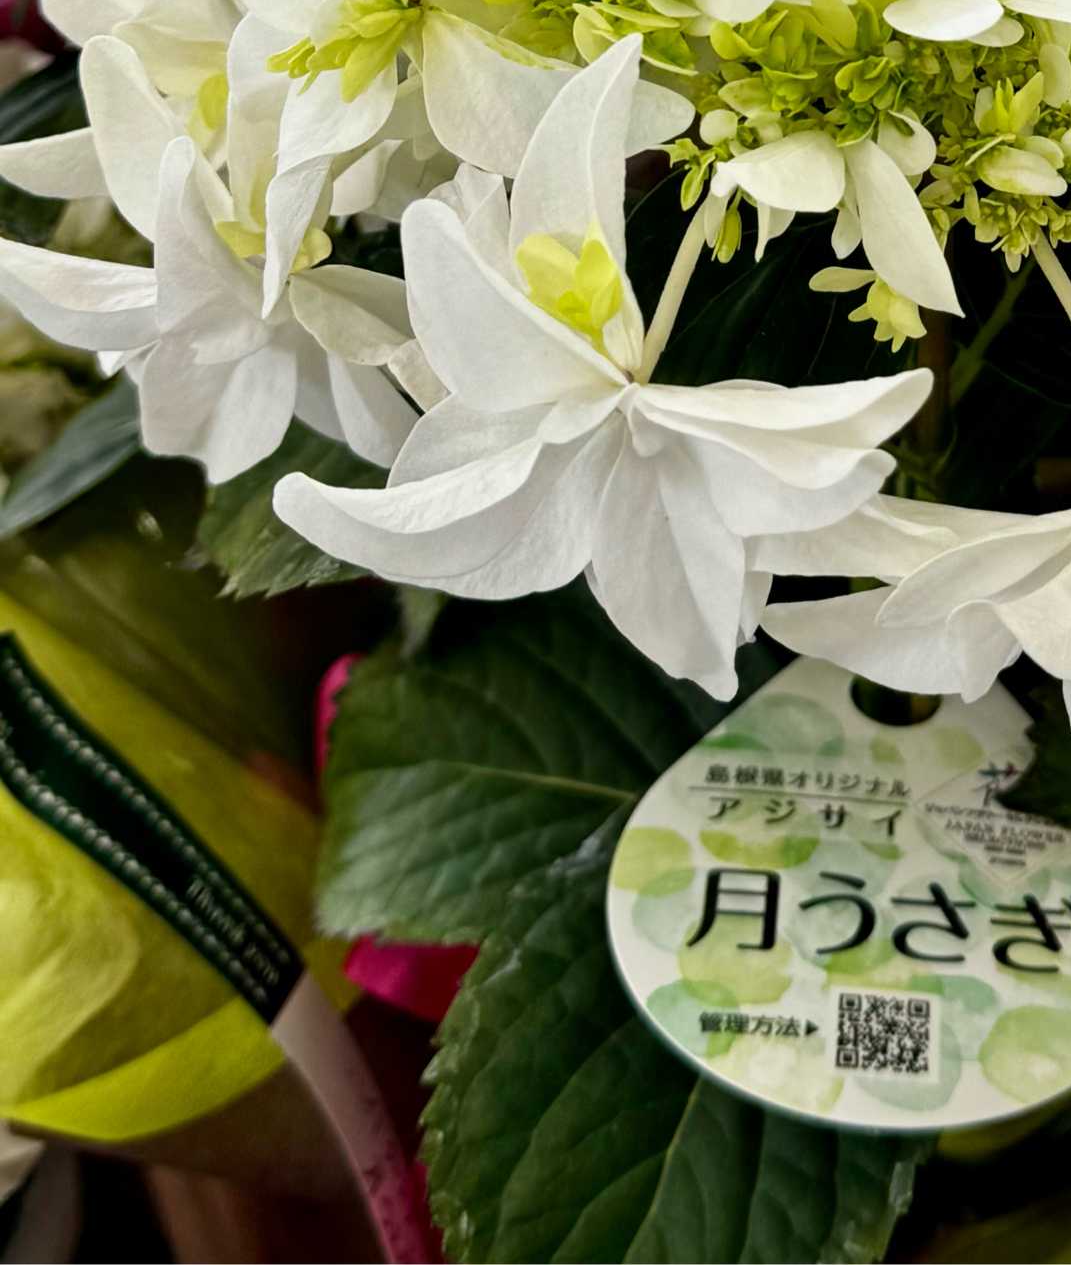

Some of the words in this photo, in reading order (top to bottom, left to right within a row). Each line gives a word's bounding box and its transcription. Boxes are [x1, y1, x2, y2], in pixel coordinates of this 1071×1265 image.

[704, 763, 912, 798] 島根県オリジナル
[707, 796, 903, 838] アジサイ
[697, 1010, 802, 1040] 管理方法
